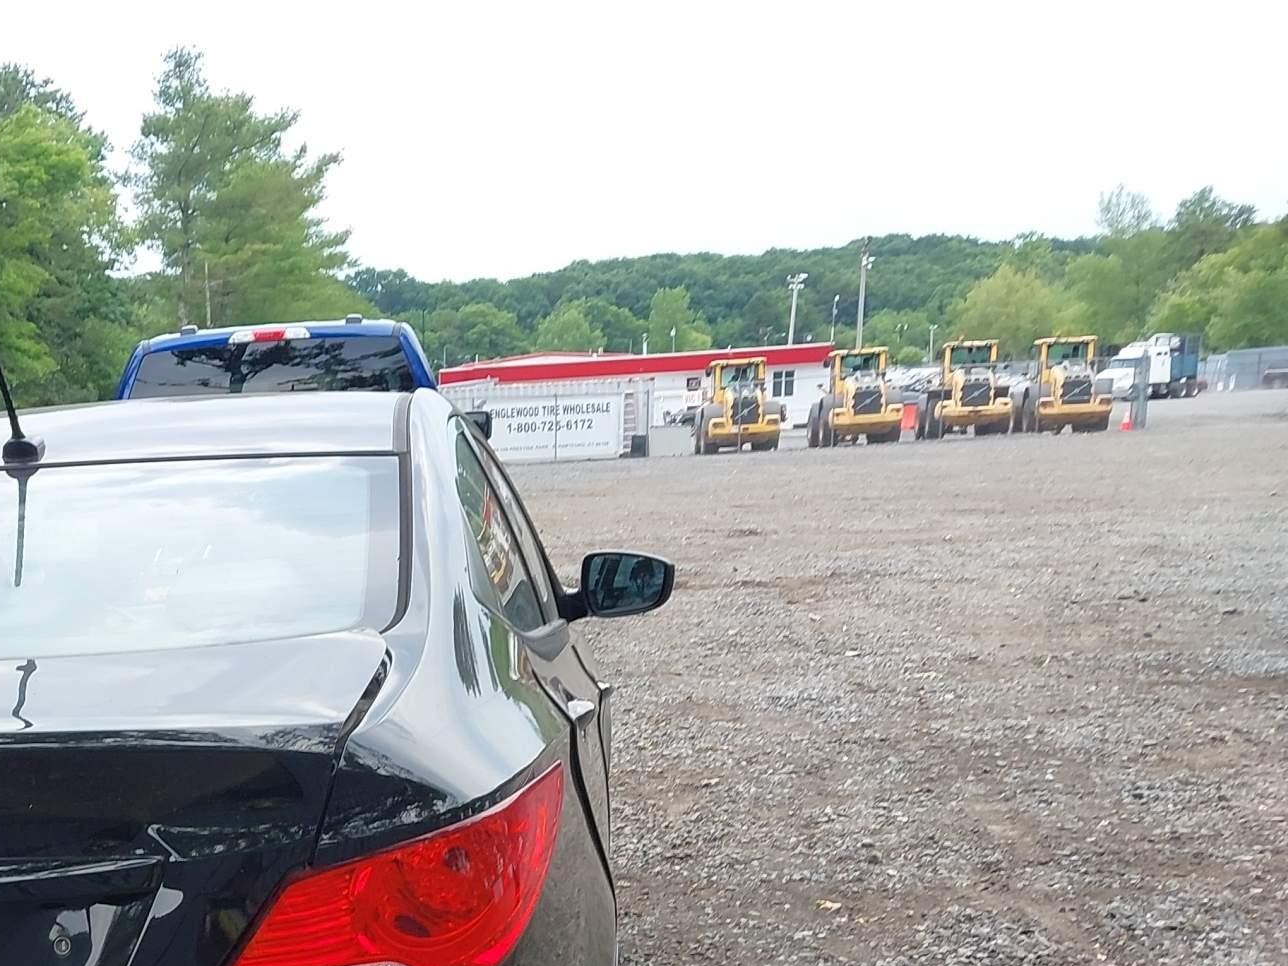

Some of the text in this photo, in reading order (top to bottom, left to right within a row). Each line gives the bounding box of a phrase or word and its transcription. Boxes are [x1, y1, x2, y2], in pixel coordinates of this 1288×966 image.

[489, 401, 611, 418] ENGLEWOOD TIRE WHOLESALE
